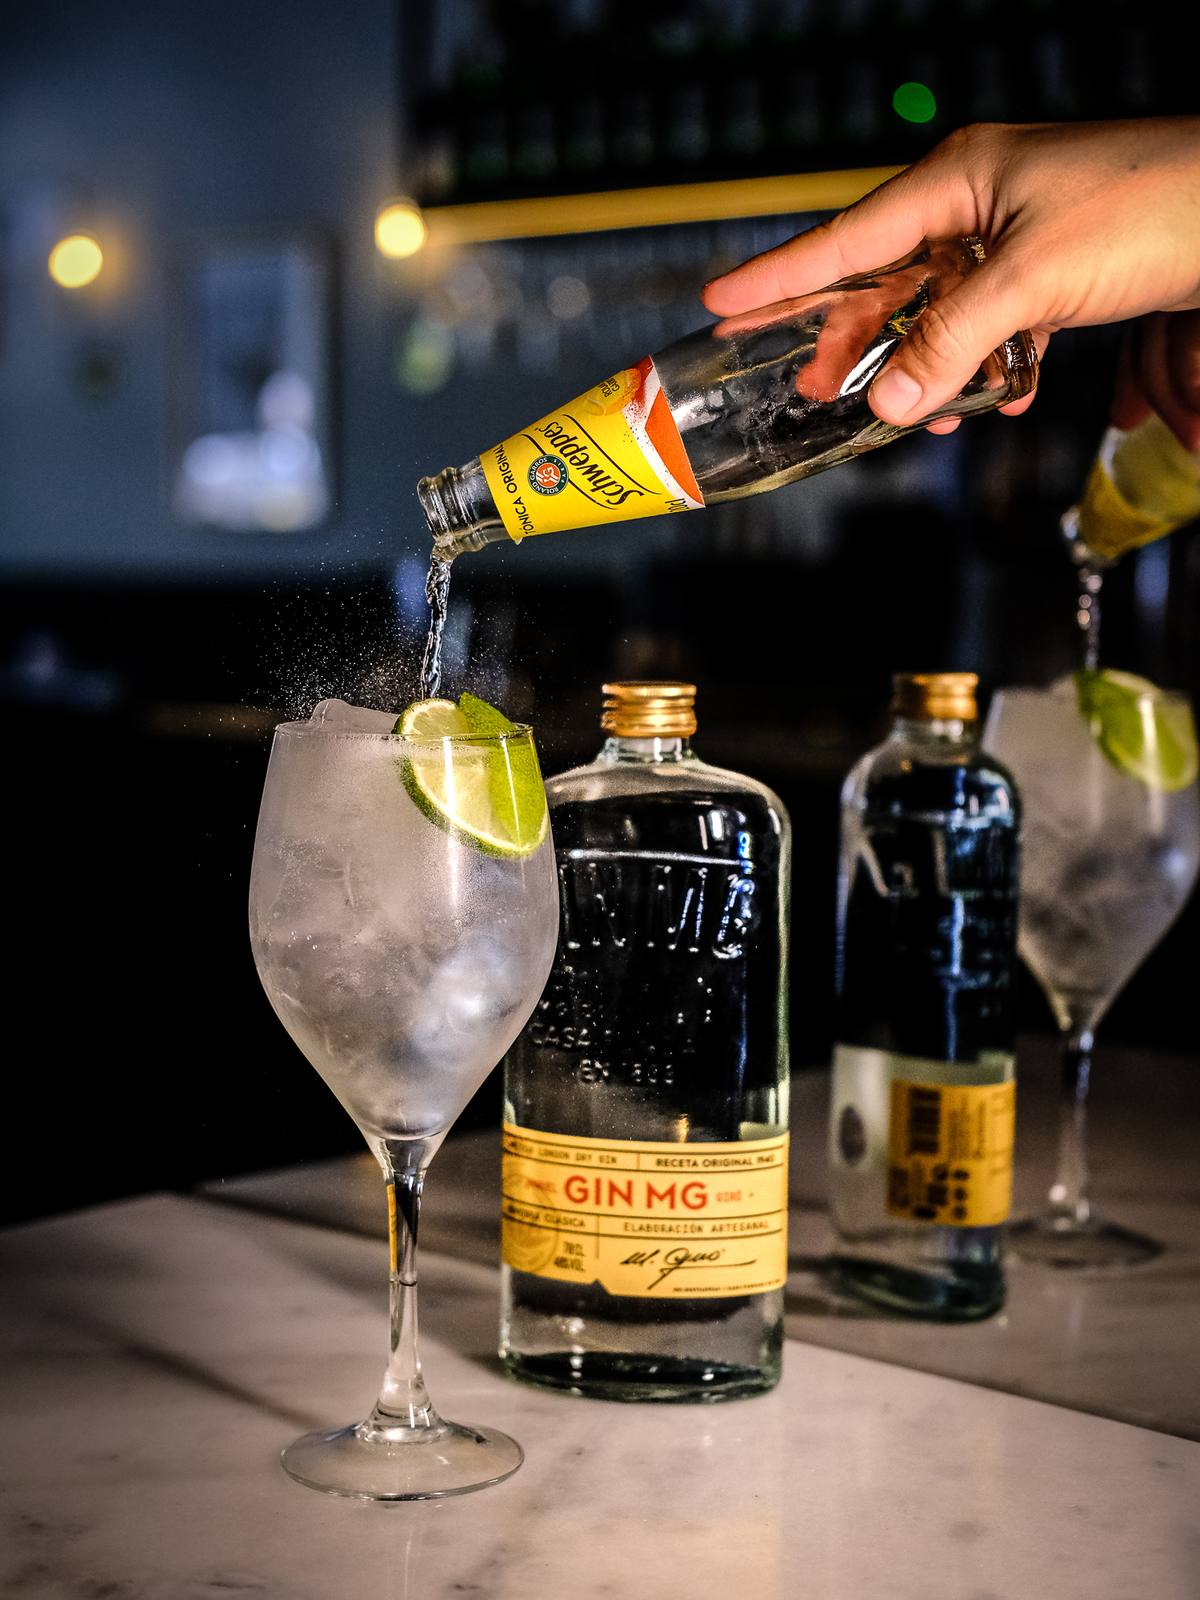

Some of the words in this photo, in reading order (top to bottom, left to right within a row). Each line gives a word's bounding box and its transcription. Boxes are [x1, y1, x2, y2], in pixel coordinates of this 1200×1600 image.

[492, 444, 517, 494] ORIGINAL
[529, 456, 548, 481] GARROS
[538, 421, 645, 506] Schweppes
[532, 481, 559, 494] ROLAND
[512, 496, 536, 535] TÓNICA
[656, 1157, 698, 1168] RECETA
[702, 1157, 753, 1168] ORIGINAL
[564, 1175, 633, 1208] GIN
[646, 1181, 708, 1211] MG
[623, 1221, 704, 1234] ELABORACIÓN
[711, 1220, 769, 1233] ARTESANAL
